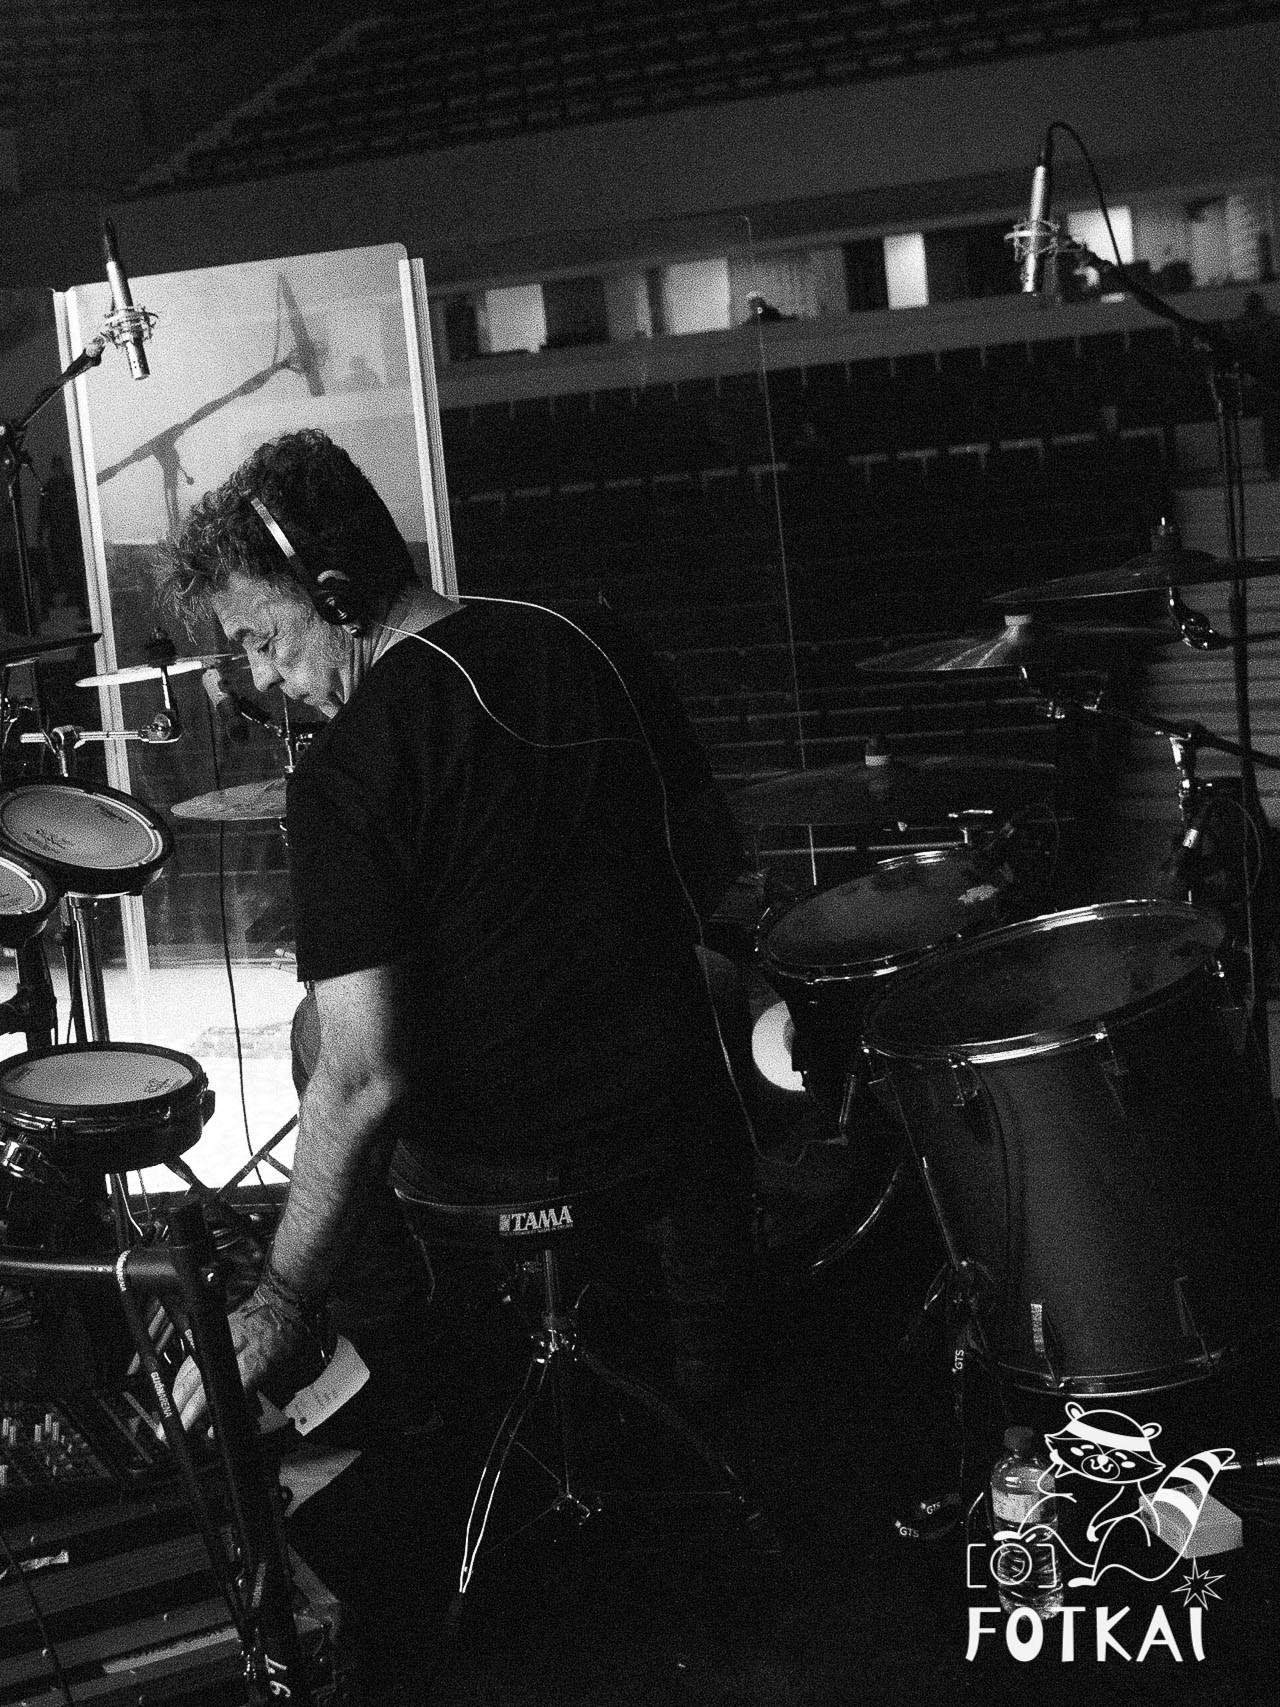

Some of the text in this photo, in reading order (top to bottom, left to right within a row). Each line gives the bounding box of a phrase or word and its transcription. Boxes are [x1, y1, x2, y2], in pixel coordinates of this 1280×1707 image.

[511, 1205, 573, 1232] TAMA
[954, 1349, 965, 1370] GTS
[899, 1526, 919, 1538] GTS
